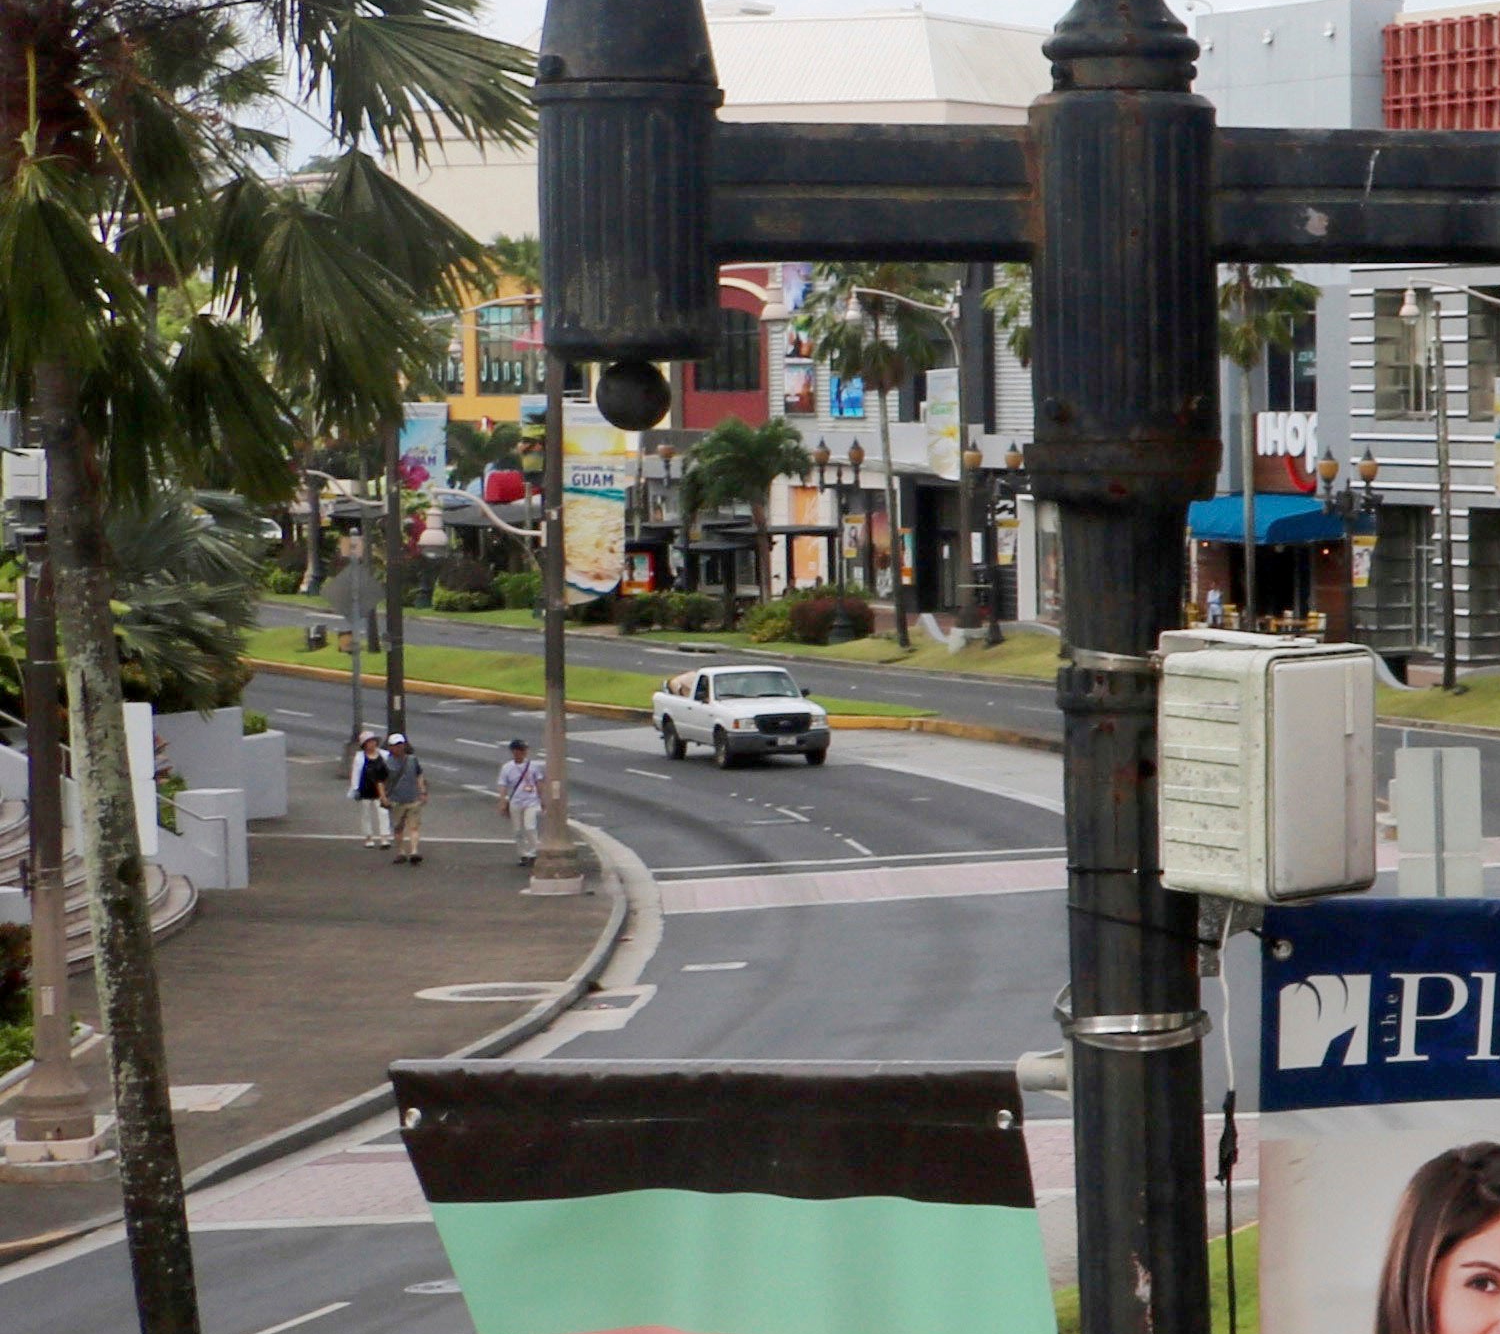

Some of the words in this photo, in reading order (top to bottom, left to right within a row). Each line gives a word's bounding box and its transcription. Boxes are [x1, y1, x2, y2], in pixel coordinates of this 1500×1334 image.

[479, 355, 545, 385] Junge
[1256, 412, 1318, 473] IHOP
[571, 472, 615, 488] GUAM
[1380, 992, 1399, 1045] the
